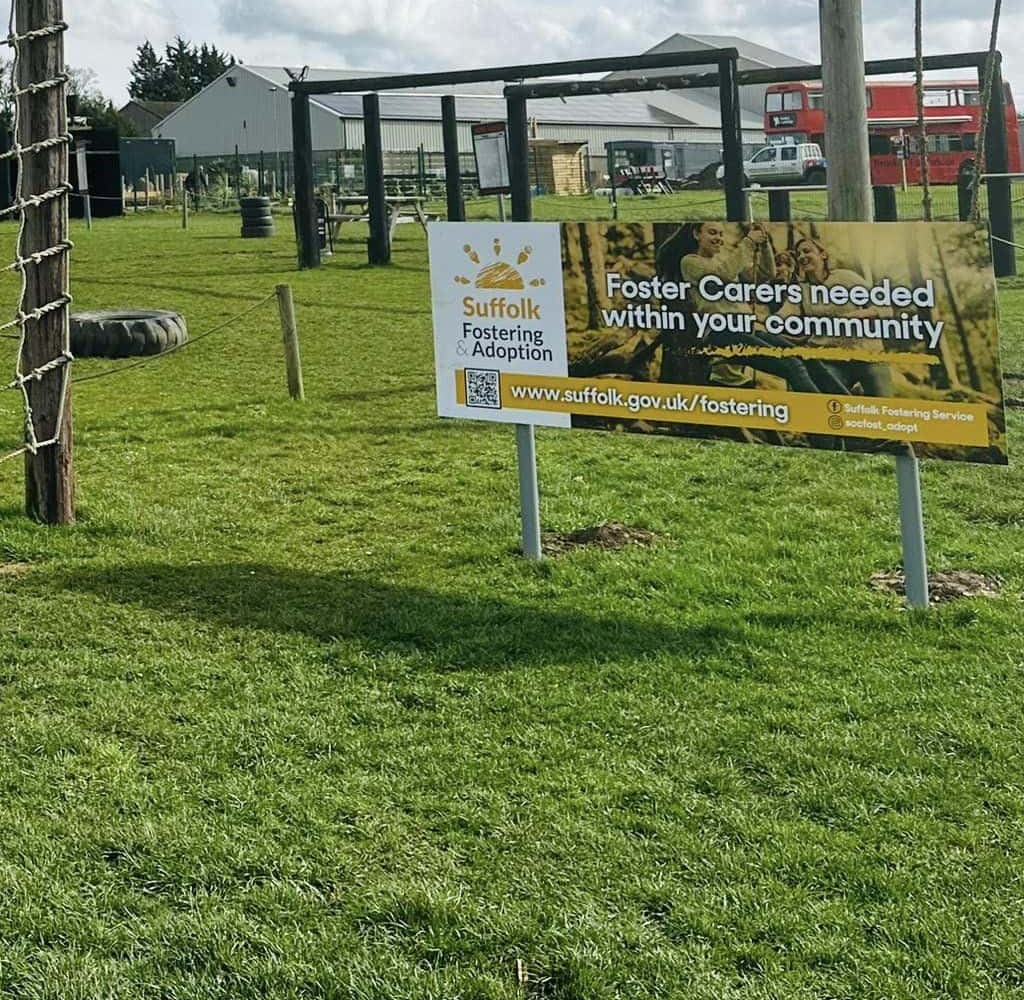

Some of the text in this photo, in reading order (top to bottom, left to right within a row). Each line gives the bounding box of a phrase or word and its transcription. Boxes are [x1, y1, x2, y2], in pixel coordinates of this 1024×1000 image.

[605, 272, 935, 308] Foster Carers needed
[462, 296, 541, 320] Suffolk
[462, 322, 544, 347] Fostering
[602, 303, 944, 349] within your community
[455, 339, 553, 363] & Adoption
[510, 384, 790, 424] www.suffolk.gov.uk/fostering
[843, 402, 974, 422] Suffolk Fostering Service
